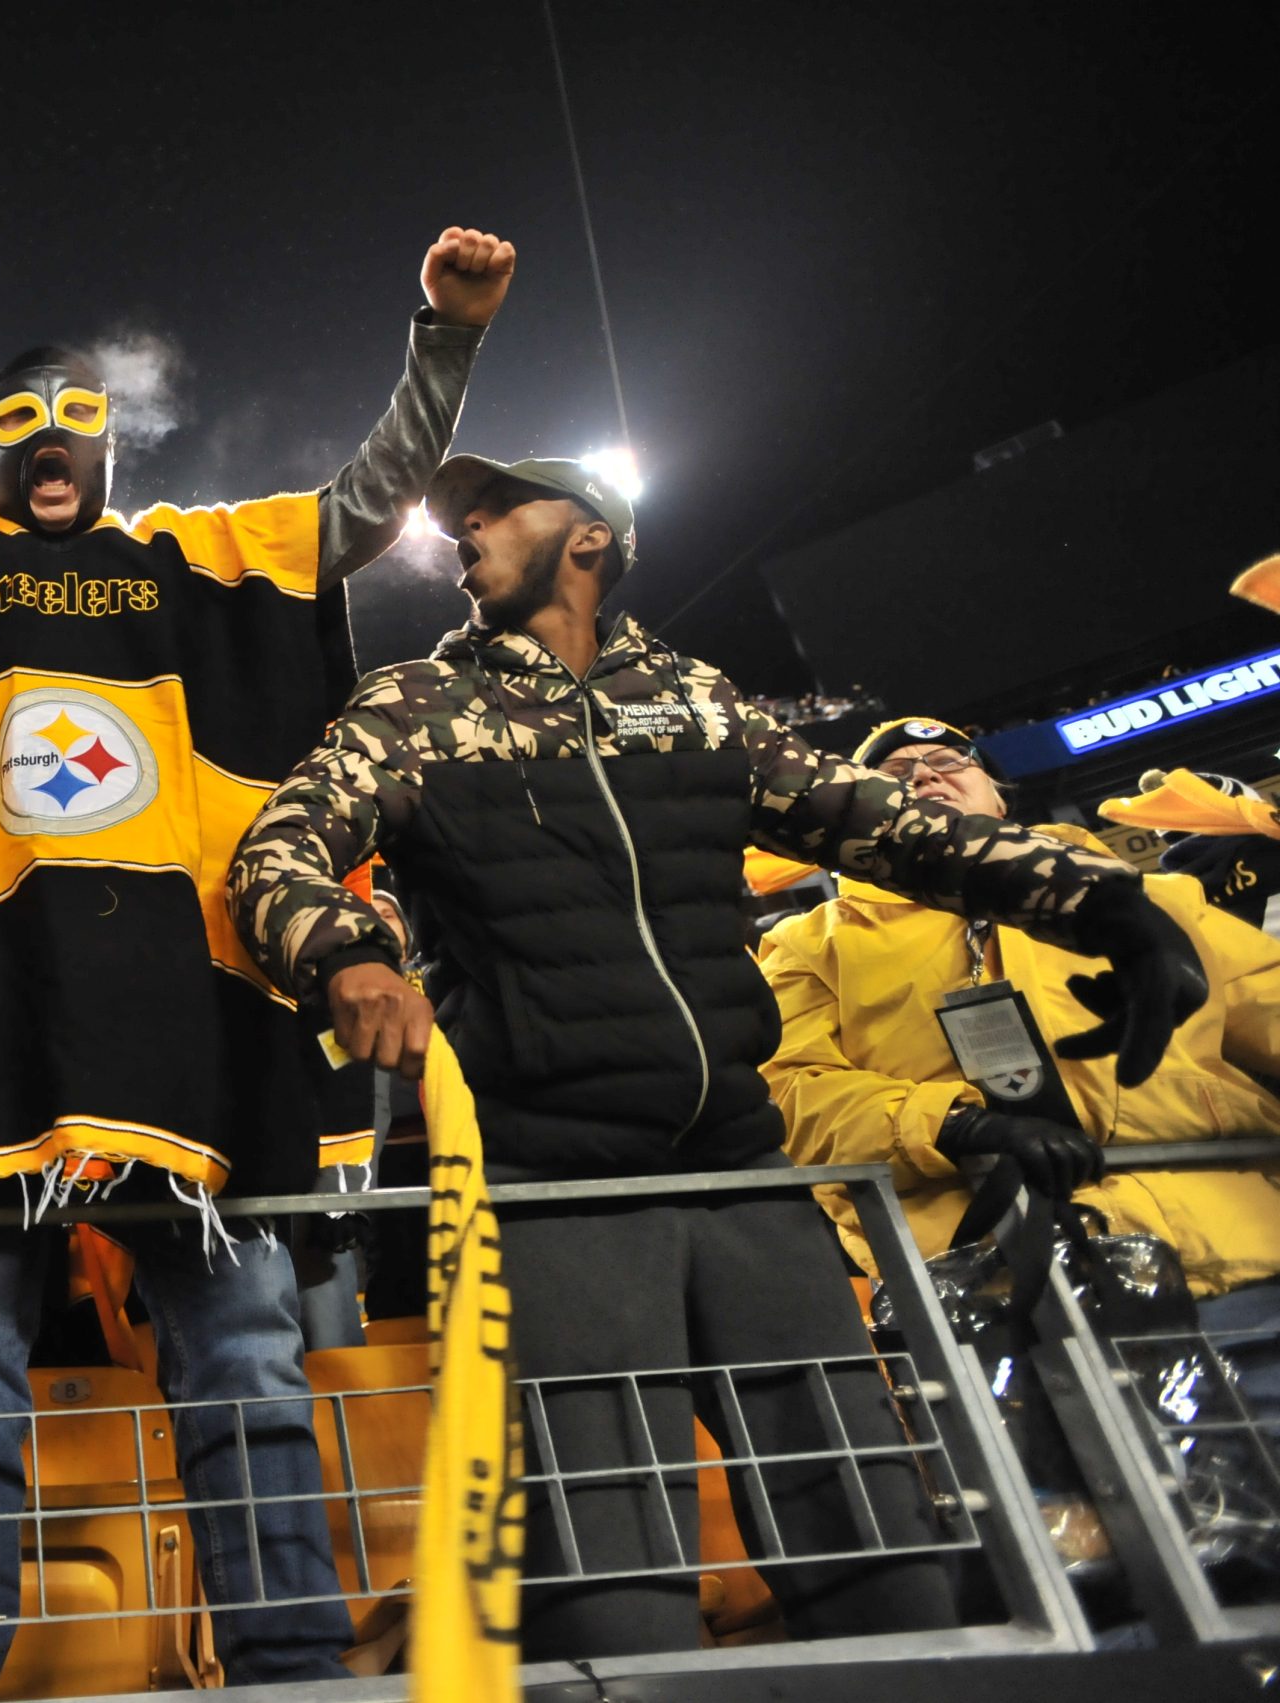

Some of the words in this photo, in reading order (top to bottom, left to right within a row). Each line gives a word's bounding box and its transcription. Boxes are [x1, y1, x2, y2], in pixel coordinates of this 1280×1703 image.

[1062, 699, 1163, 749] BUD
[1158, 654, 1280, 717] LIGHT
[617, 726, 656, 737] PROPERTY
[657, 726, 666, 735] OF
[65, 1382, 78, 1399] 8
